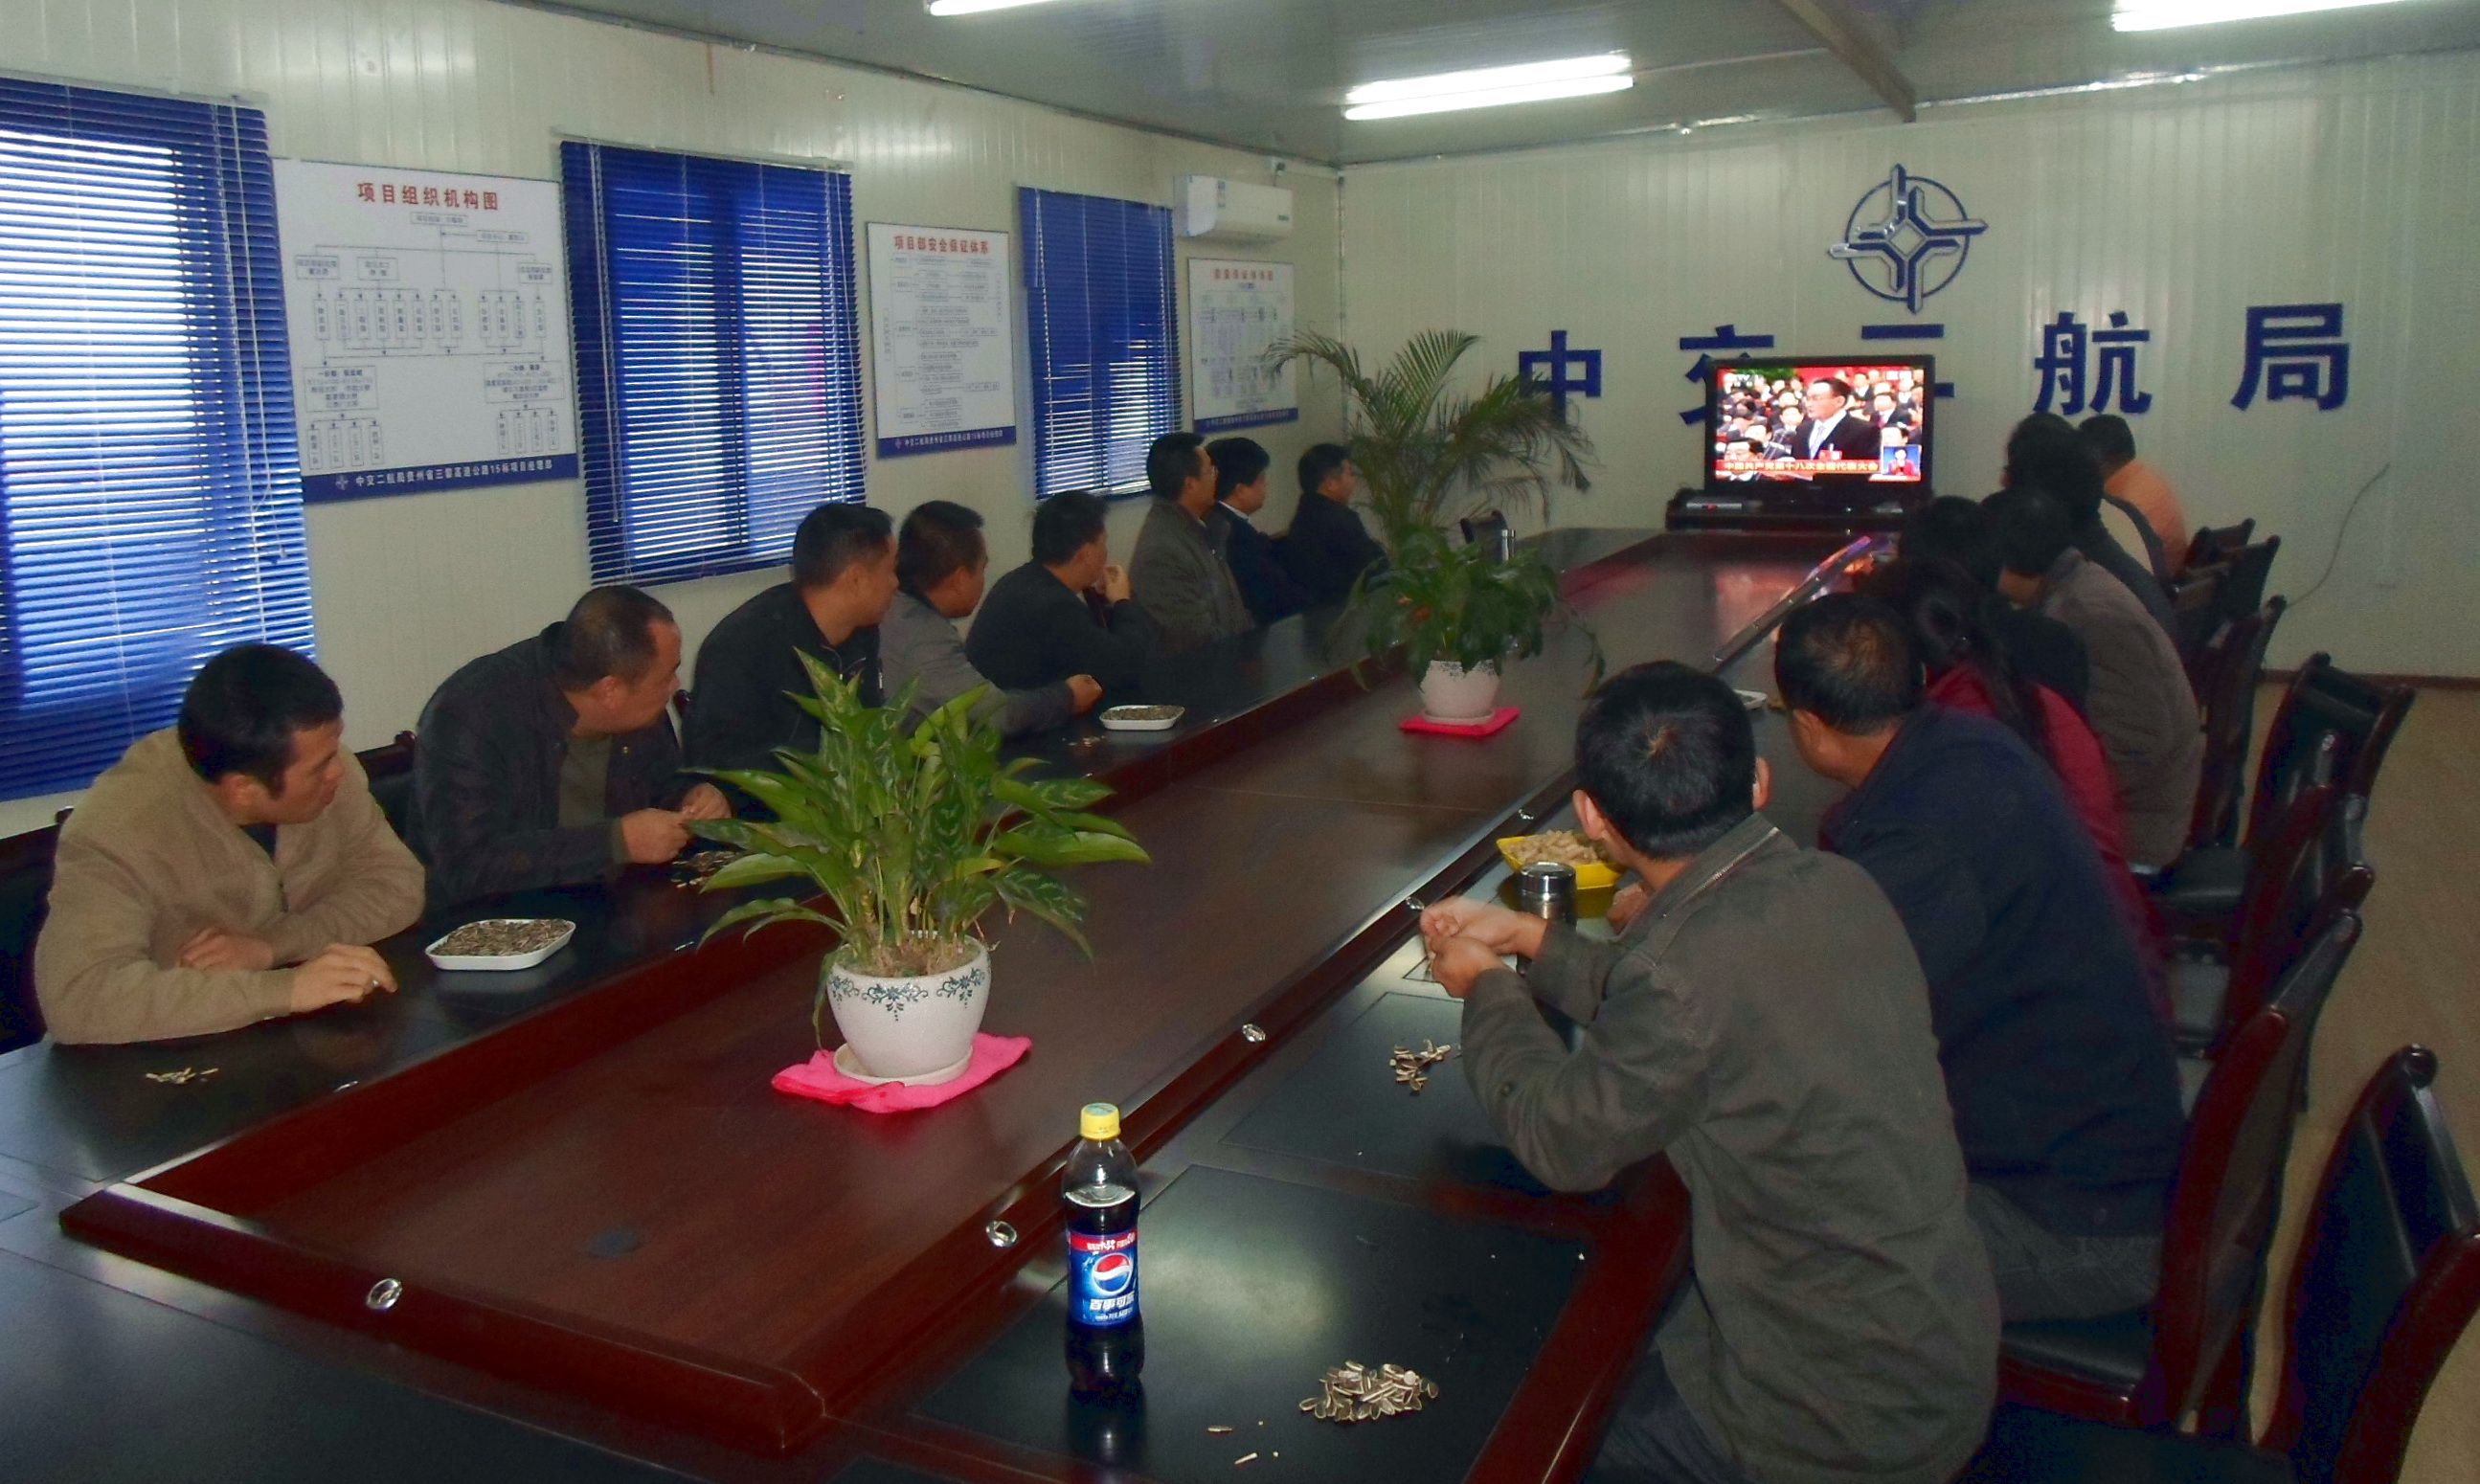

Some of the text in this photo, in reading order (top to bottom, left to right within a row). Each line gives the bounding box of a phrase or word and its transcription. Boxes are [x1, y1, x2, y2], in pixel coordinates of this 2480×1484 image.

[357, 182, 499, 211] 项目组织机构图
[893, 235, 990, 255] 项目部安全保证体系
